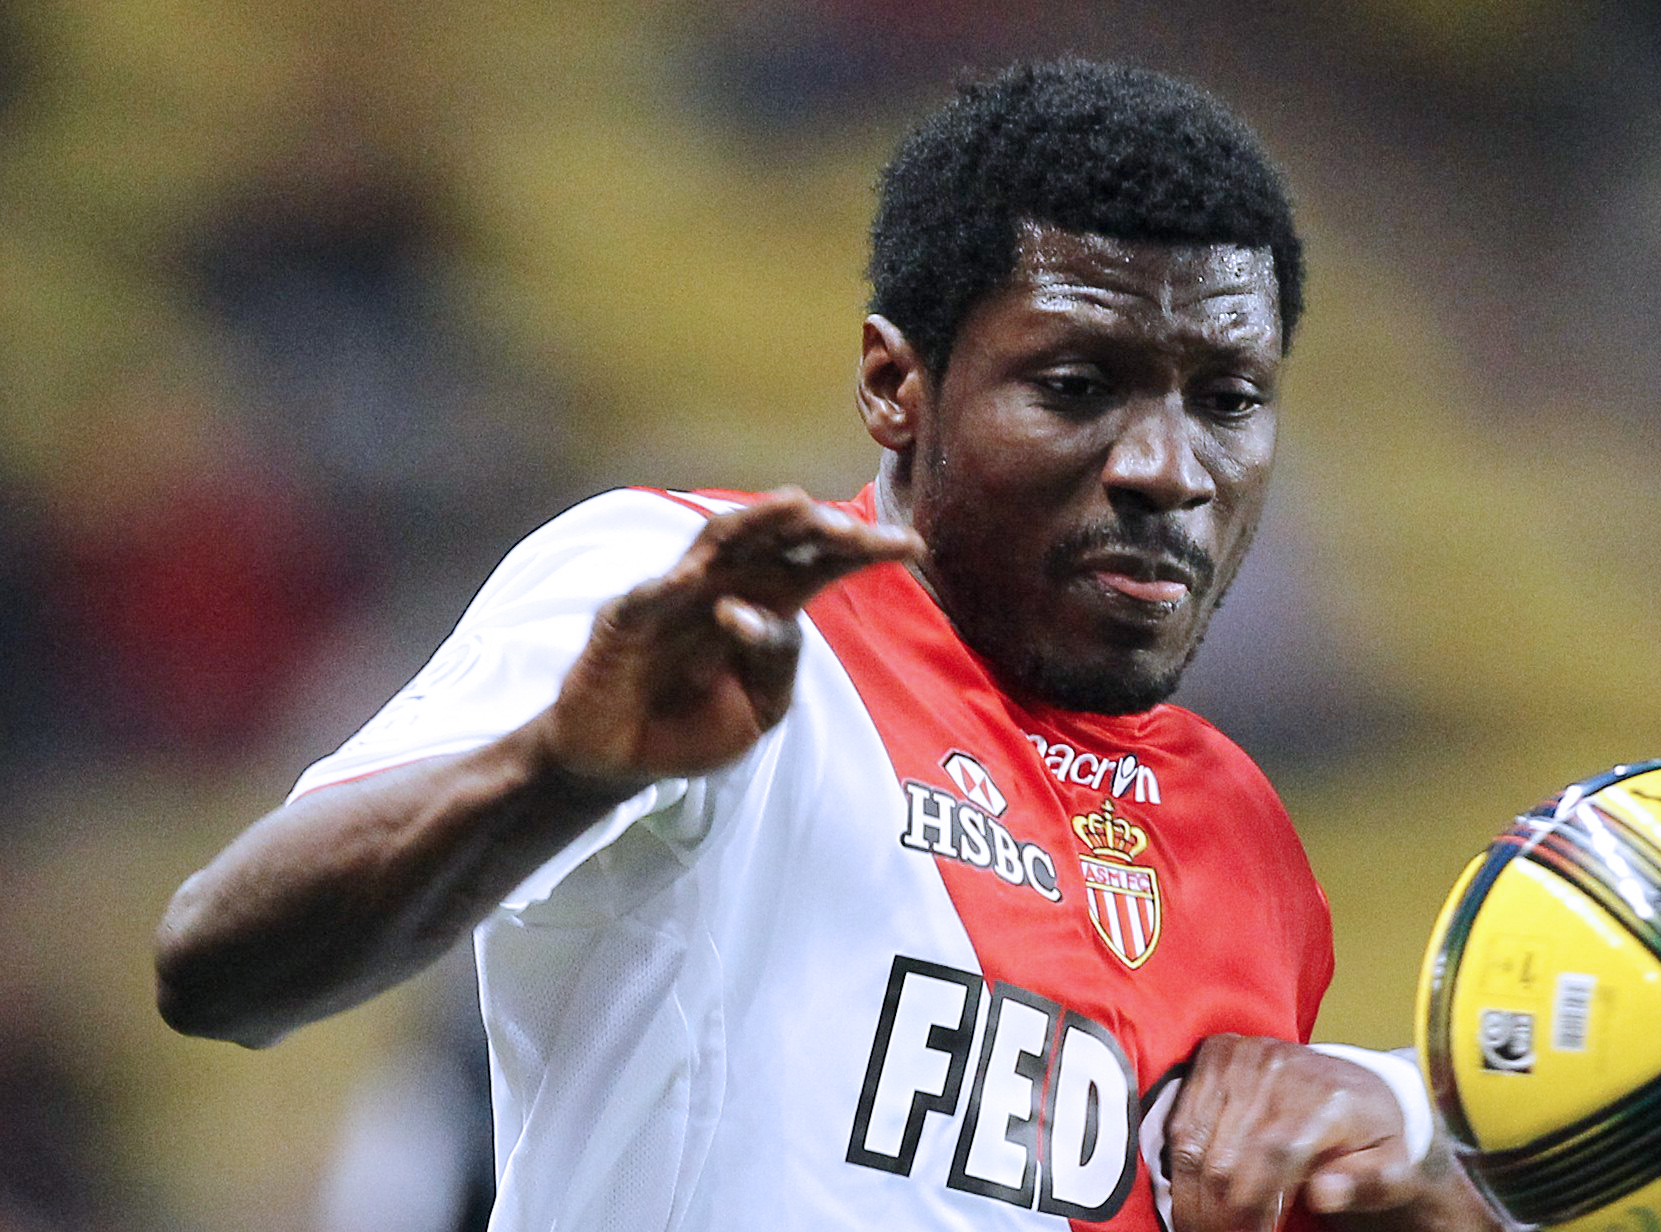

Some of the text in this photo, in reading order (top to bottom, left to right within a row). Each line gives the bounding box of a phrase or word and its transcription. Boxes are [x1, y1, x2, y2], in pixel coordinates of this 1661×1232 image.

[902, 782, 1063, 903] HSBC
[1085, 863, 1151, 893] ASM FC
